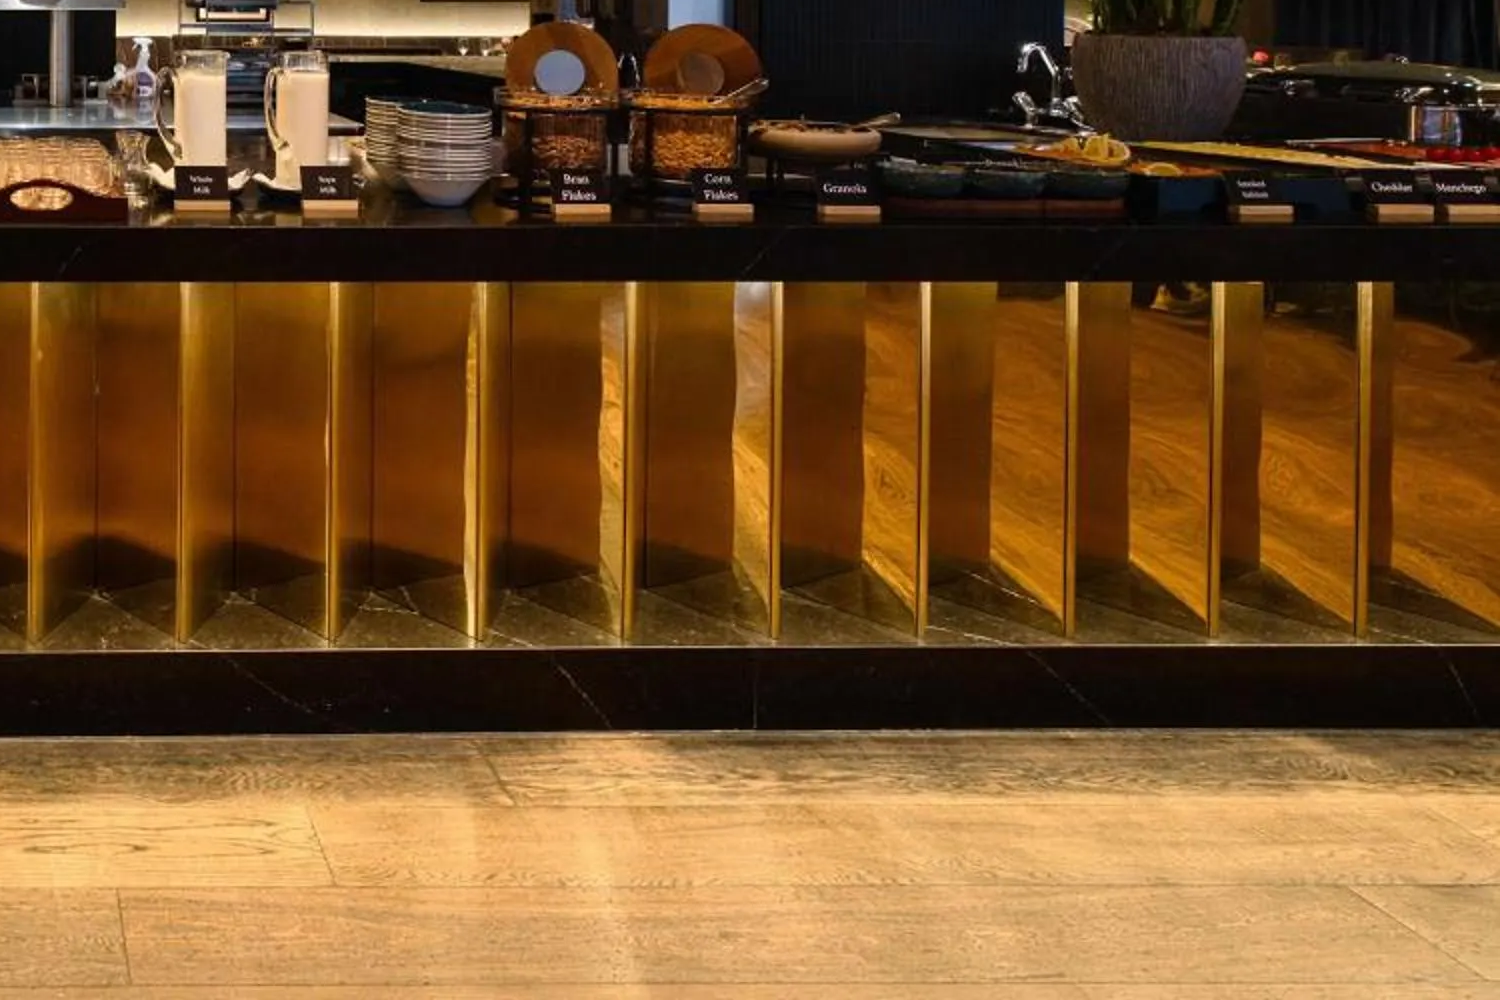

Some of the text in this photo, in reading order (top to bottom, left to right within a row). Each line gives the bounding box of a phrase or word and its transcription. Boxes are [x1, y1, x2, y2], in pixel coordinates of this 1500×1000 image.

[703, 173, 733, 185] Corn
[823, 182, 868, 195] Granola
[1435, 182, 1487, 195] Manchego
[561, 189, 597, 201] Flakes
[703, 189, 739, 201] Flakes
